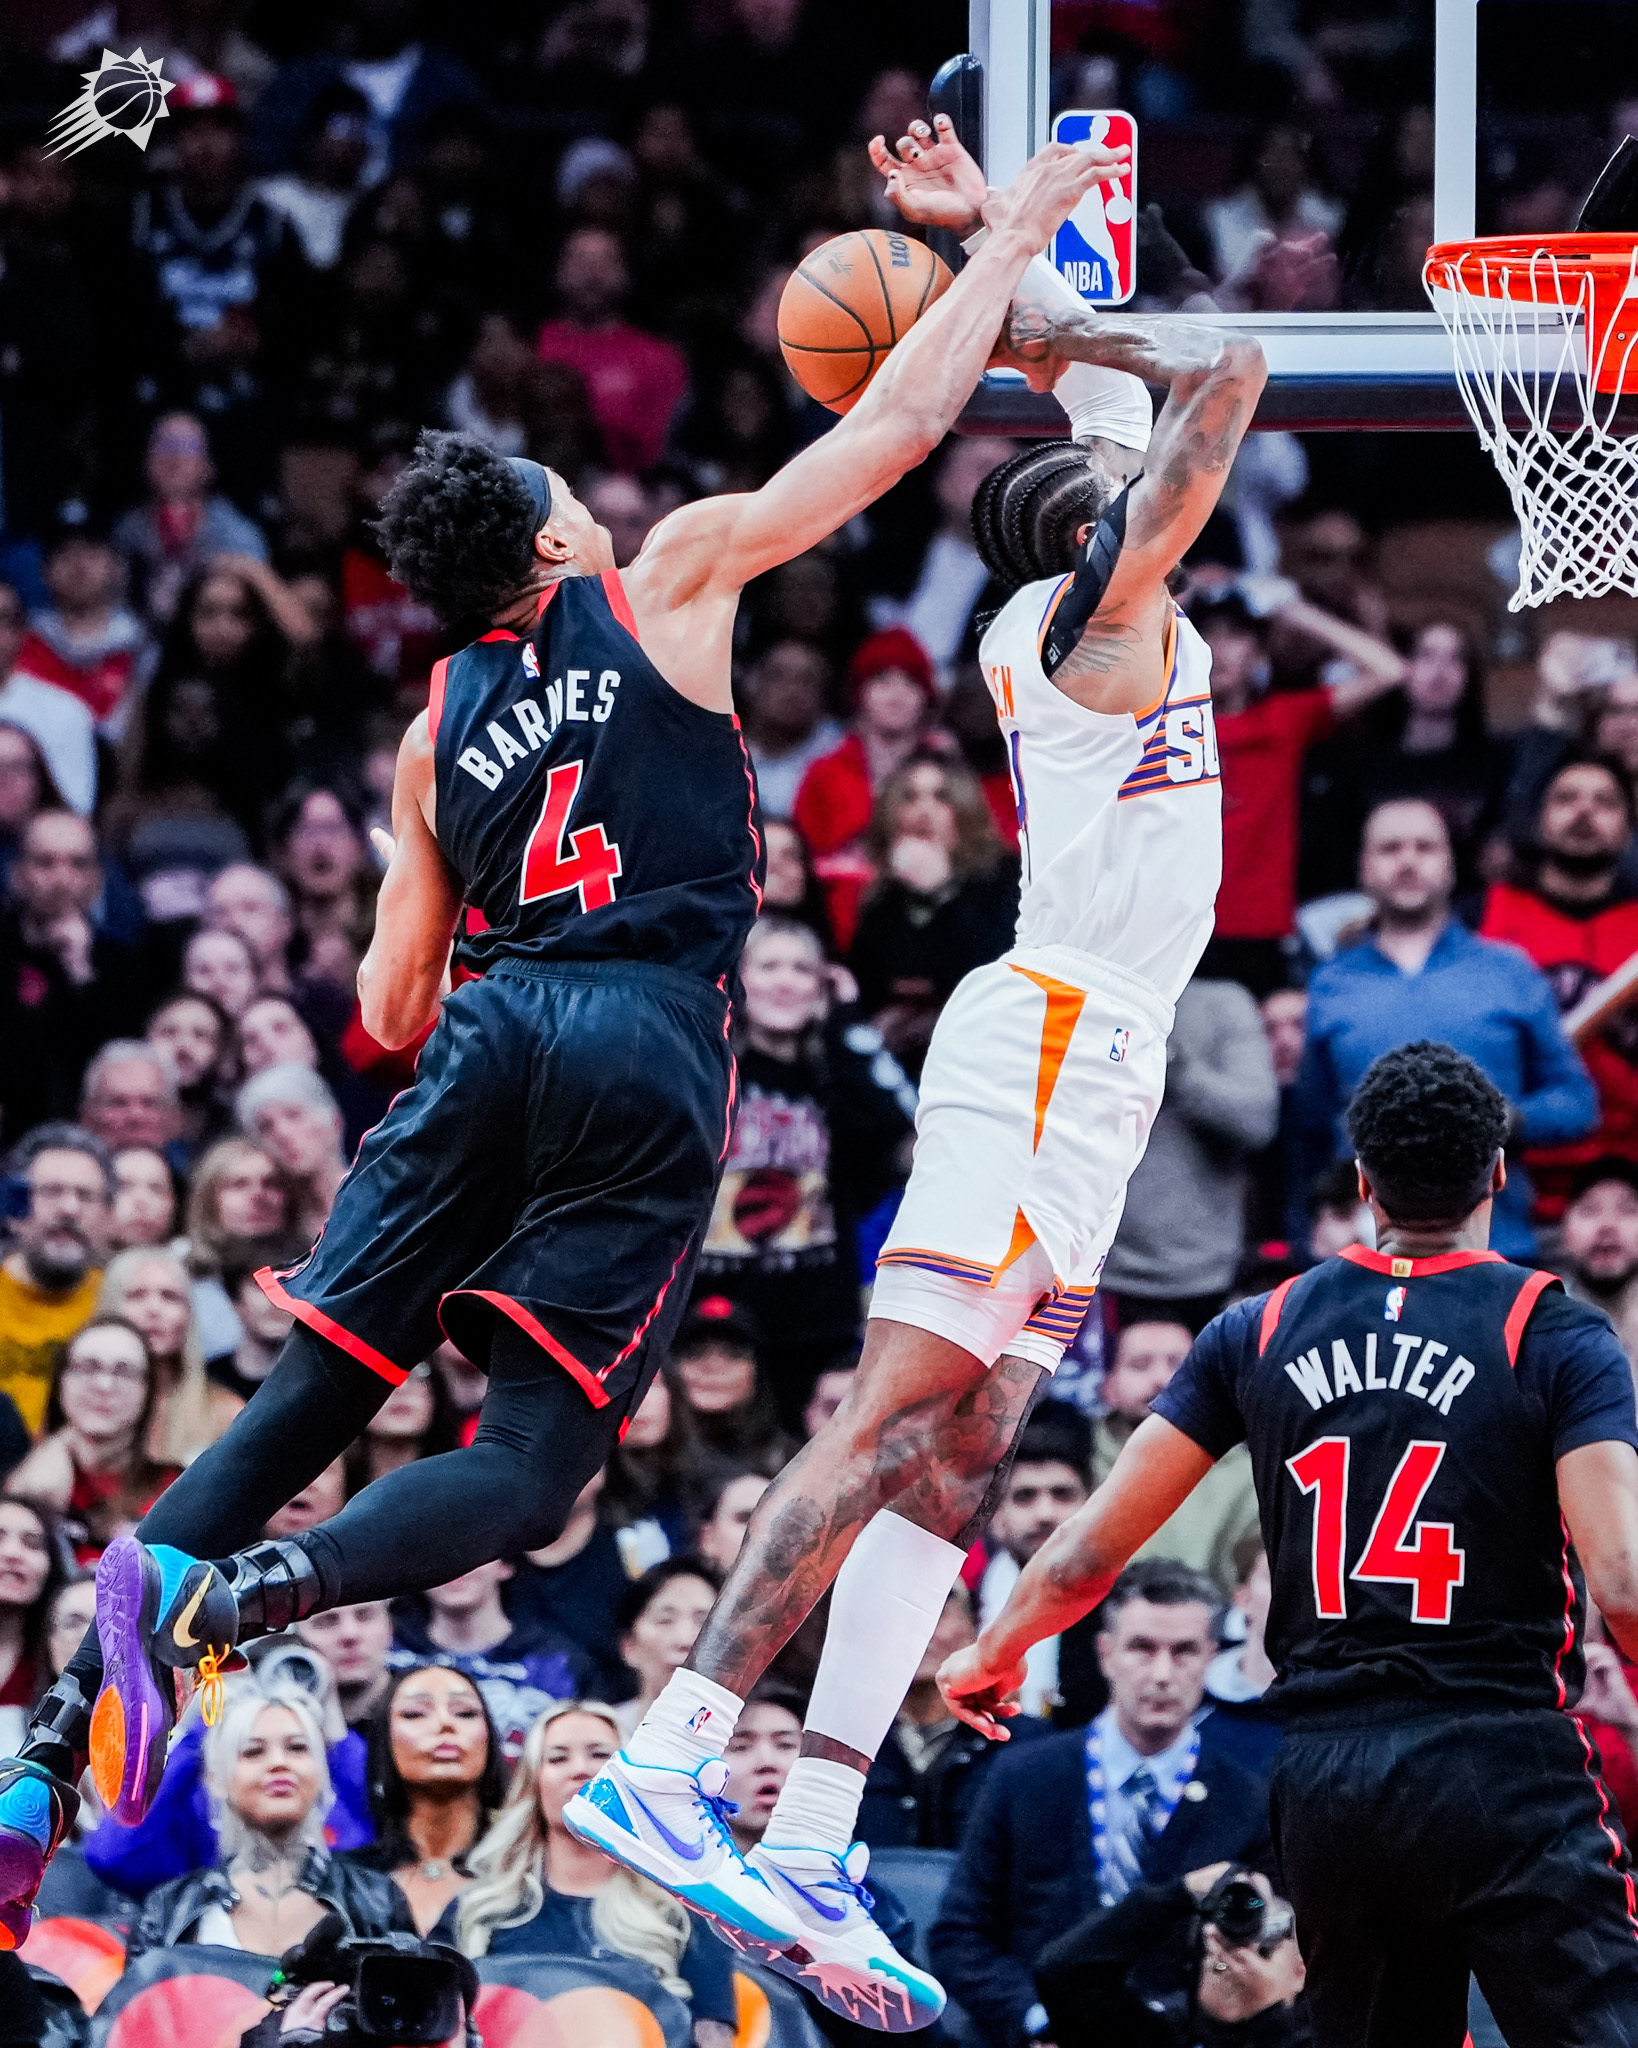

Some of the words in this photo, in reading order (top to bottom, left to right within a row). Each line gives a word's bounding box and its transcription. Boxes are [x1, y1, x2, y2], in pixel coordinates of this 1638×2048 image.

[1064, 261, 1103, 292] NBA
[457, 669, 621, 792] BARNES
[519, 759, 623, 914] 4
[1284, 1333, 1475, 1416] WALTER
[1284, 1436, 1465, 1625] 14
